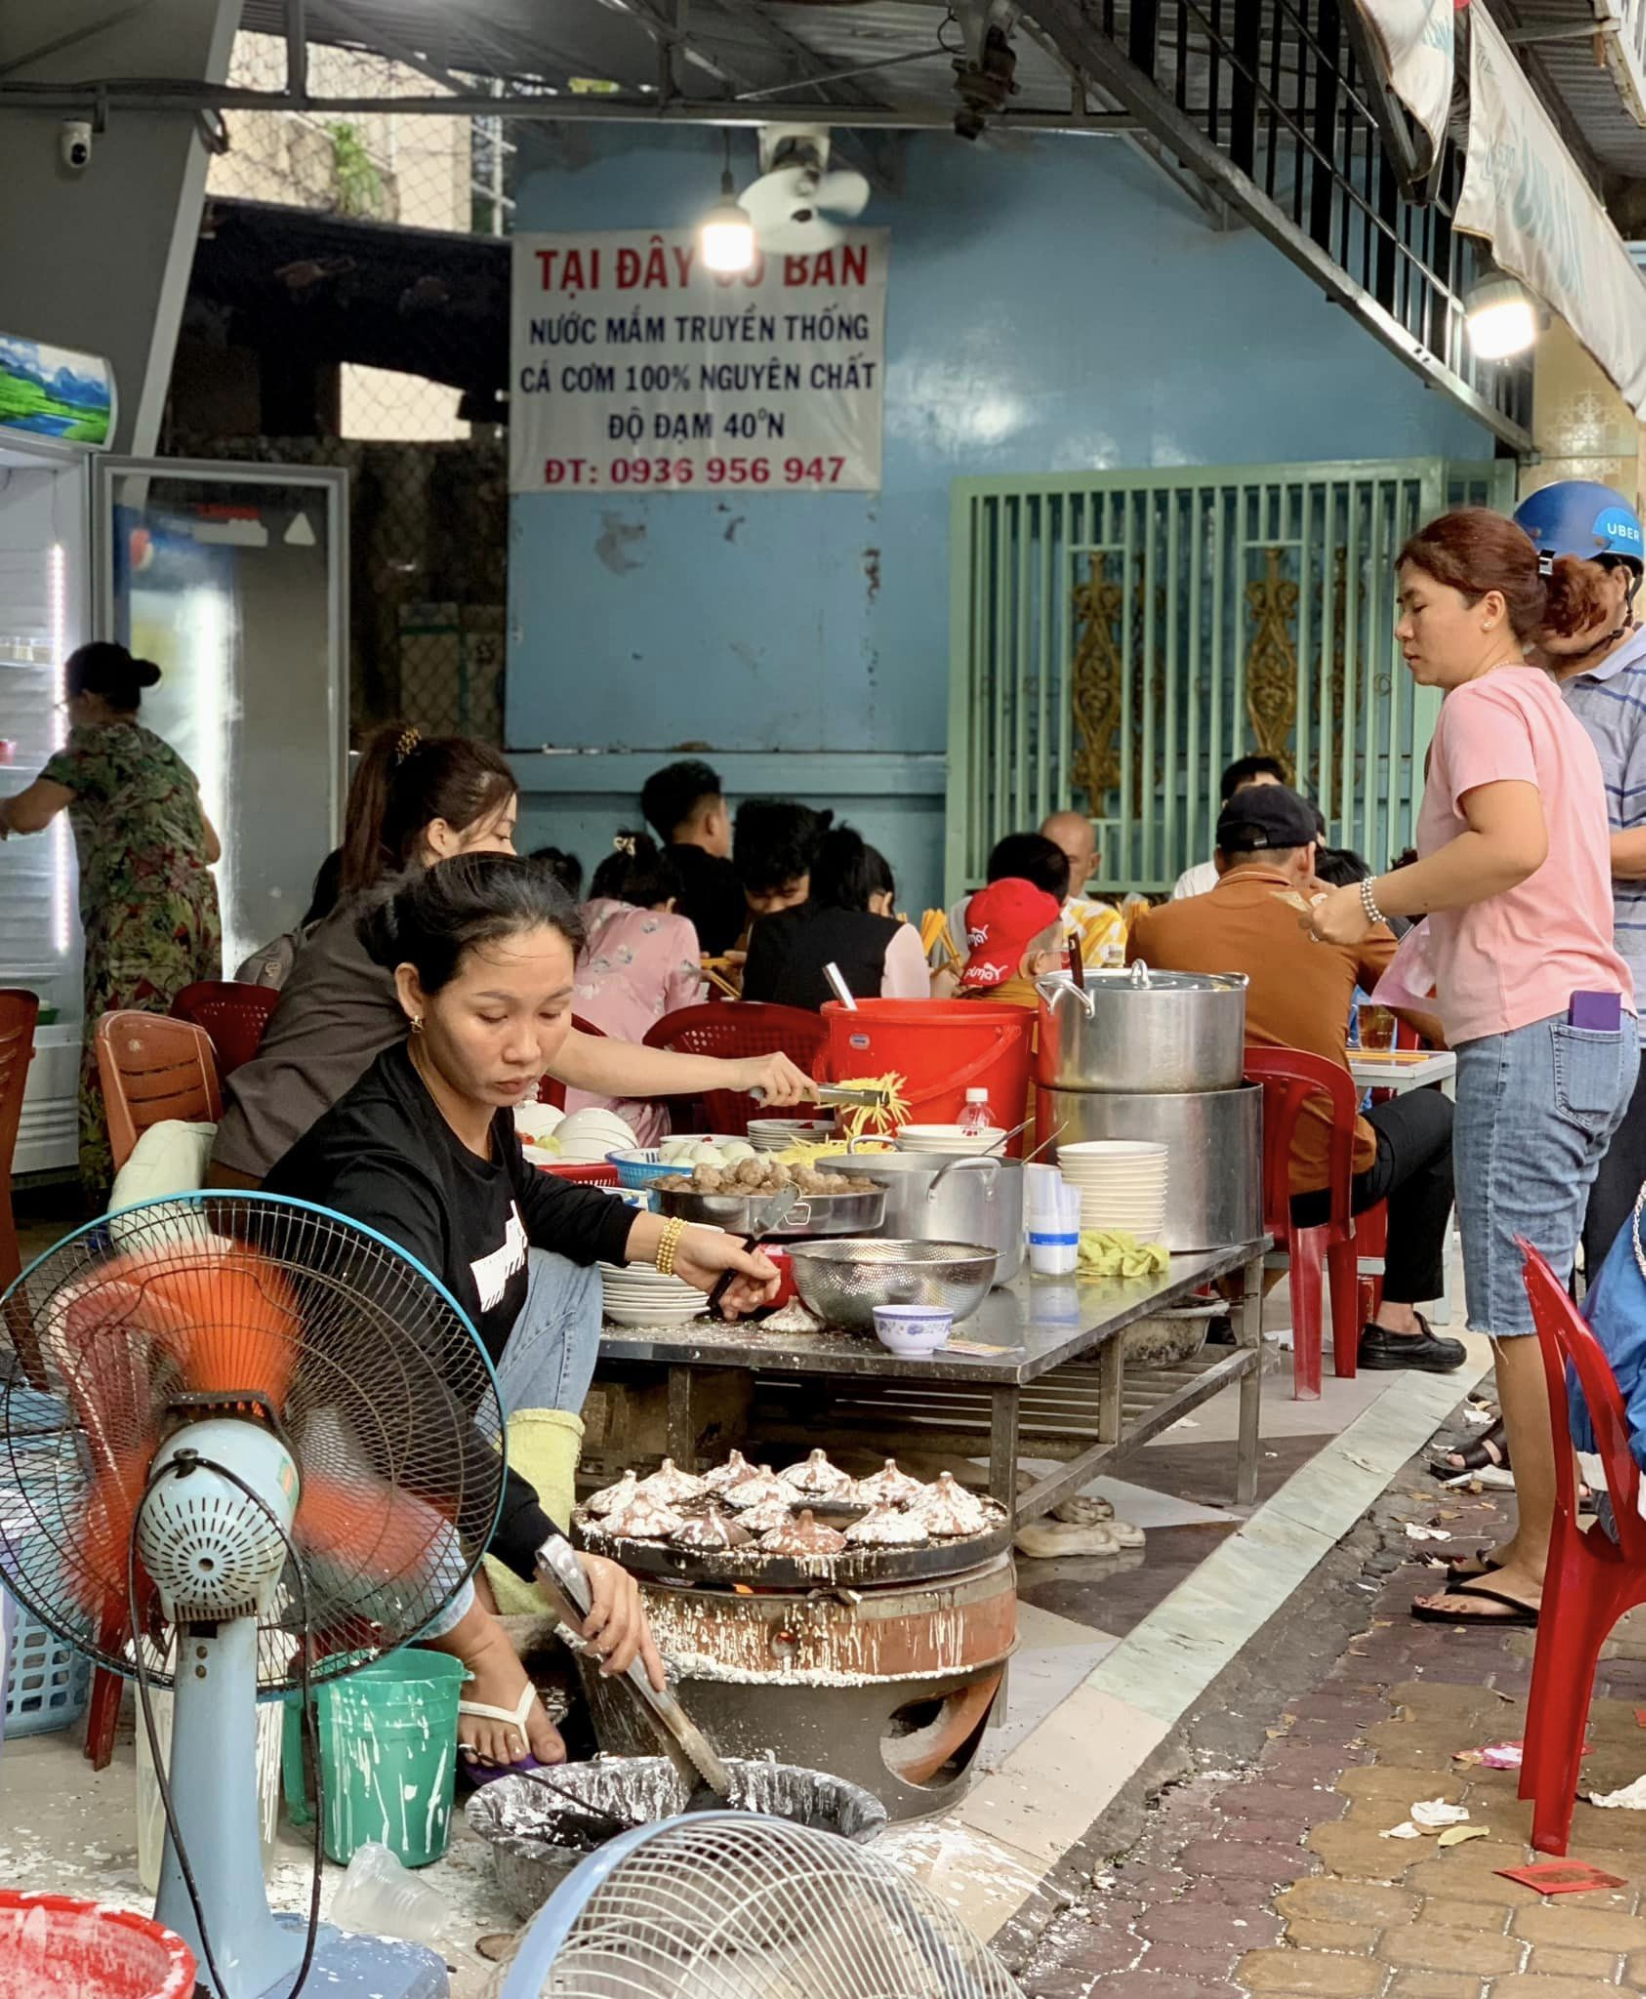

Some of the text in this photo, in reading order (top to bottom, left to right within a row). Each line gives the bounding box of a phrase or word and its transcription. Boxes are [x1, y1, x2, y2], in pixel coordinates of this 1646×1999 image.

[535, 248, 600, 300] TẠI
[615, 234, 697, 290] ĐÂY
[530, 310, 597, 345] NƯỚC
[675, 301, 775, 342] TRUYỀN
[784, 302, 870, 342] THỐNG
[520, 352, 877, 393] CÁ CƠM 100% NGUYÊN CHẤT
[608, 406, 644, 445] ĐỘ
[654, 413, 714, 445] ĐẠM
[544, 456, 847, 485] ĐT: 0936 956 947
[1607, 522, 1640, 543] UBER
